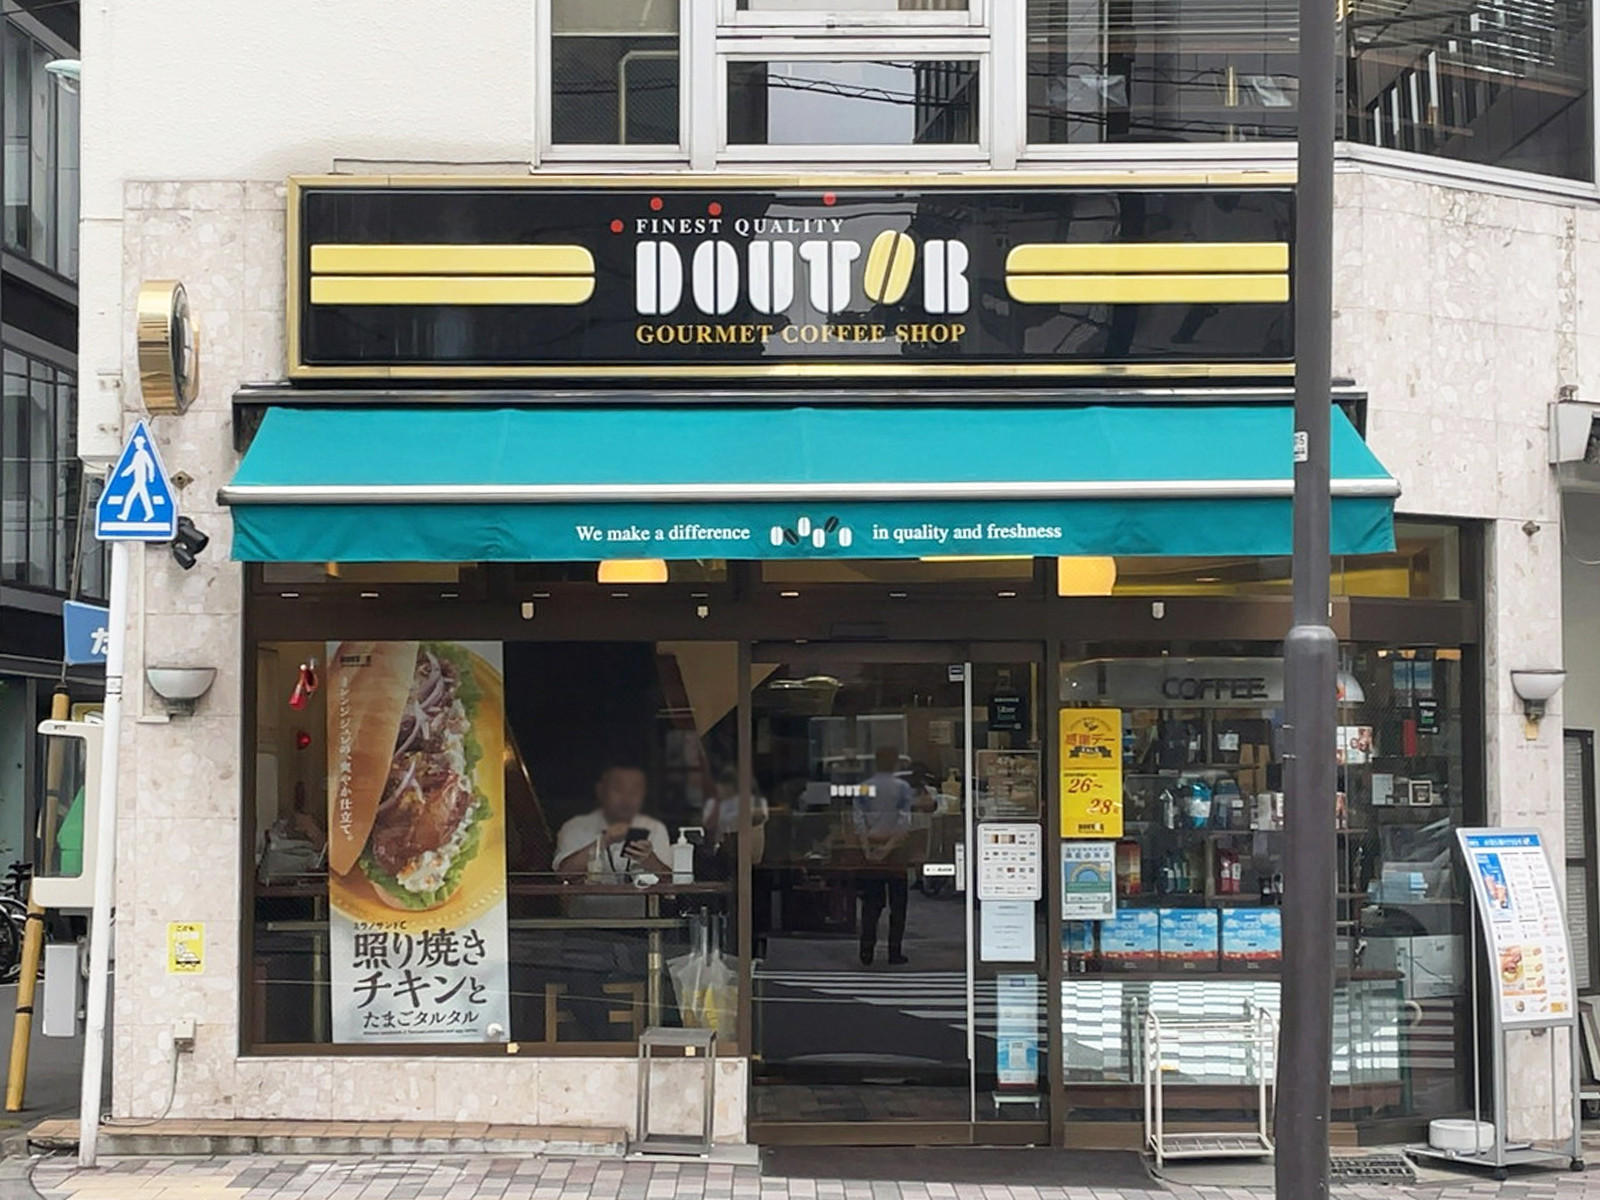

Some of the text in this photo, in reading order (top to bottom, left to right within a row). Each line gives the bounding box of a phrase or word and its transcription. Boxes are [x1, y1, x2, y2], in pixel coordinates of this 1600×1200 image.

[636, 218, 844, 236] FINEST QUALITY
[635, 229, 970, 315] DOUTOR
[636, 323, 966, 344] GOURMET COFFEE SHOP
[576, 524, 751, 541] We make a difference
[872, 523, 1063, 544] in quality and freshness
[1162, 677, 1269, 700] COFFEE
[830, 784, 876, 797] DOUTOR
[352, 927, 486, 970] 照り焼き
[353, 968, 487, 1009] チキンと
[363, 1010, 479, 1029] たまごタルタル
